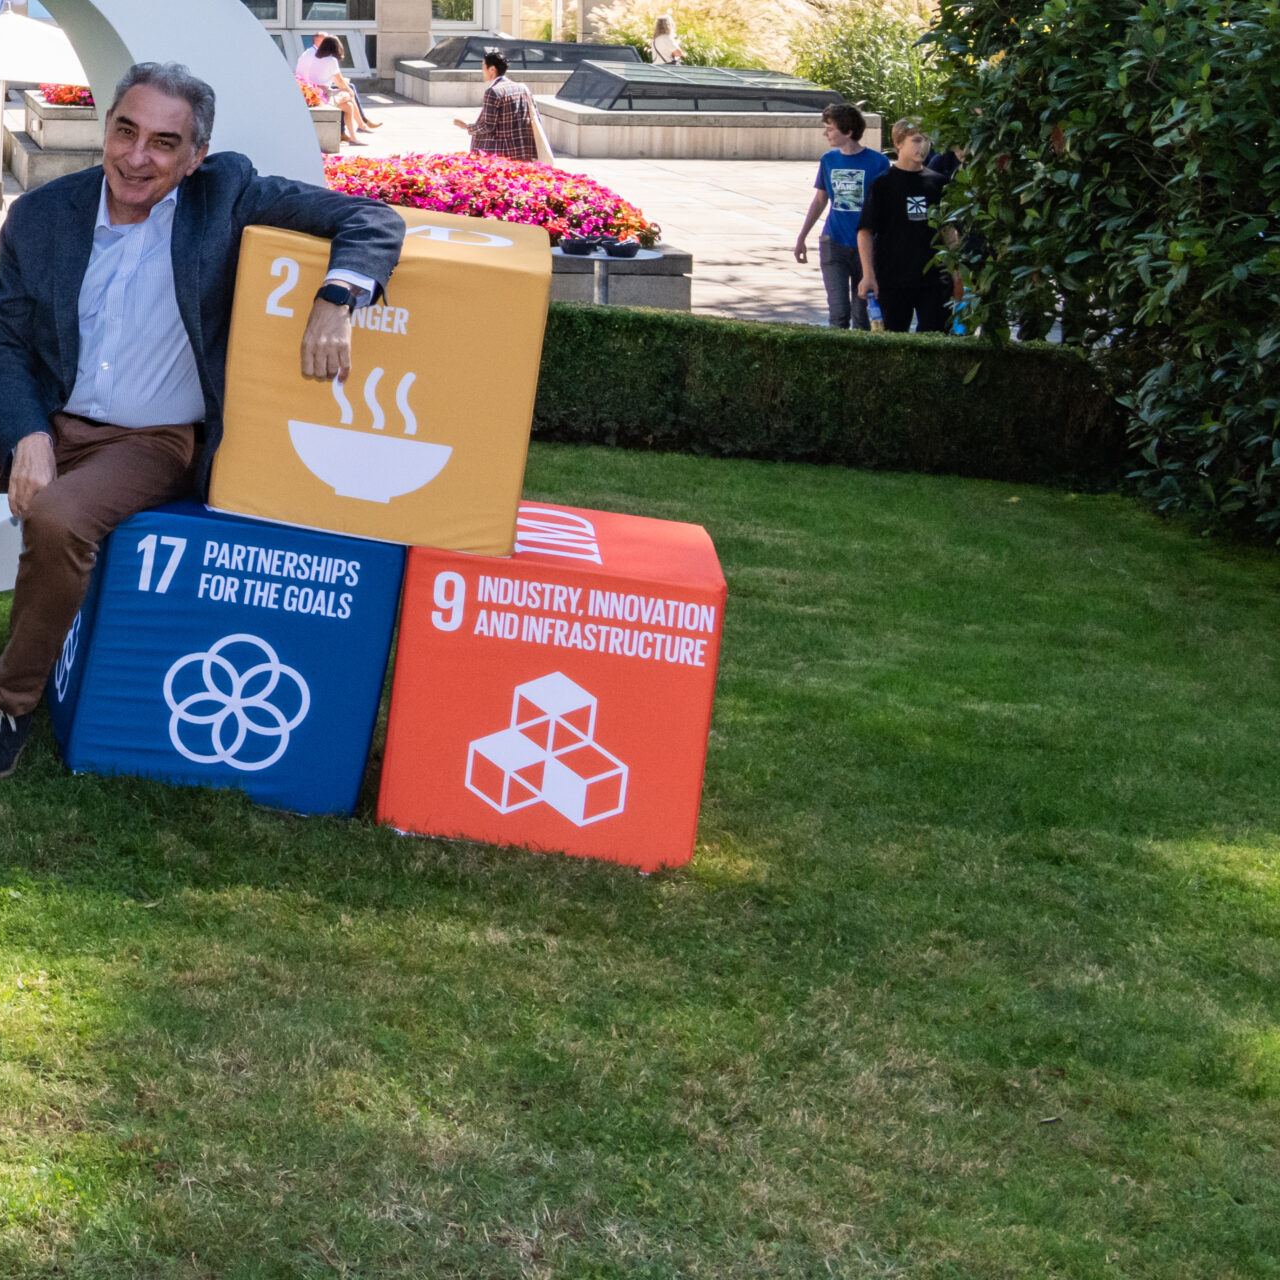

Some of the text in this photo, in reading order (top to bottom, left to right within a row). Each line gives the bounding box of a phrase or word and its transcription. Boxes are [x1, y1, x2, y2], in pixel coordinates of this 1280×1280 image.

[266, 257, 299, 317] 2
[351, 305, 409, 335] NGER
[138, 534, 187, 593] 17
[203, 541, 360, 586] PARTNERSHIPS
[198, 574, 352, 619] FOR THE GOALS
[432, 571, 466, 631] 9
[478, 576, 715, 633] INDUSTRY, INNOVATION
[474, 610, 707, 667] AND INFRASTRUCTURE
